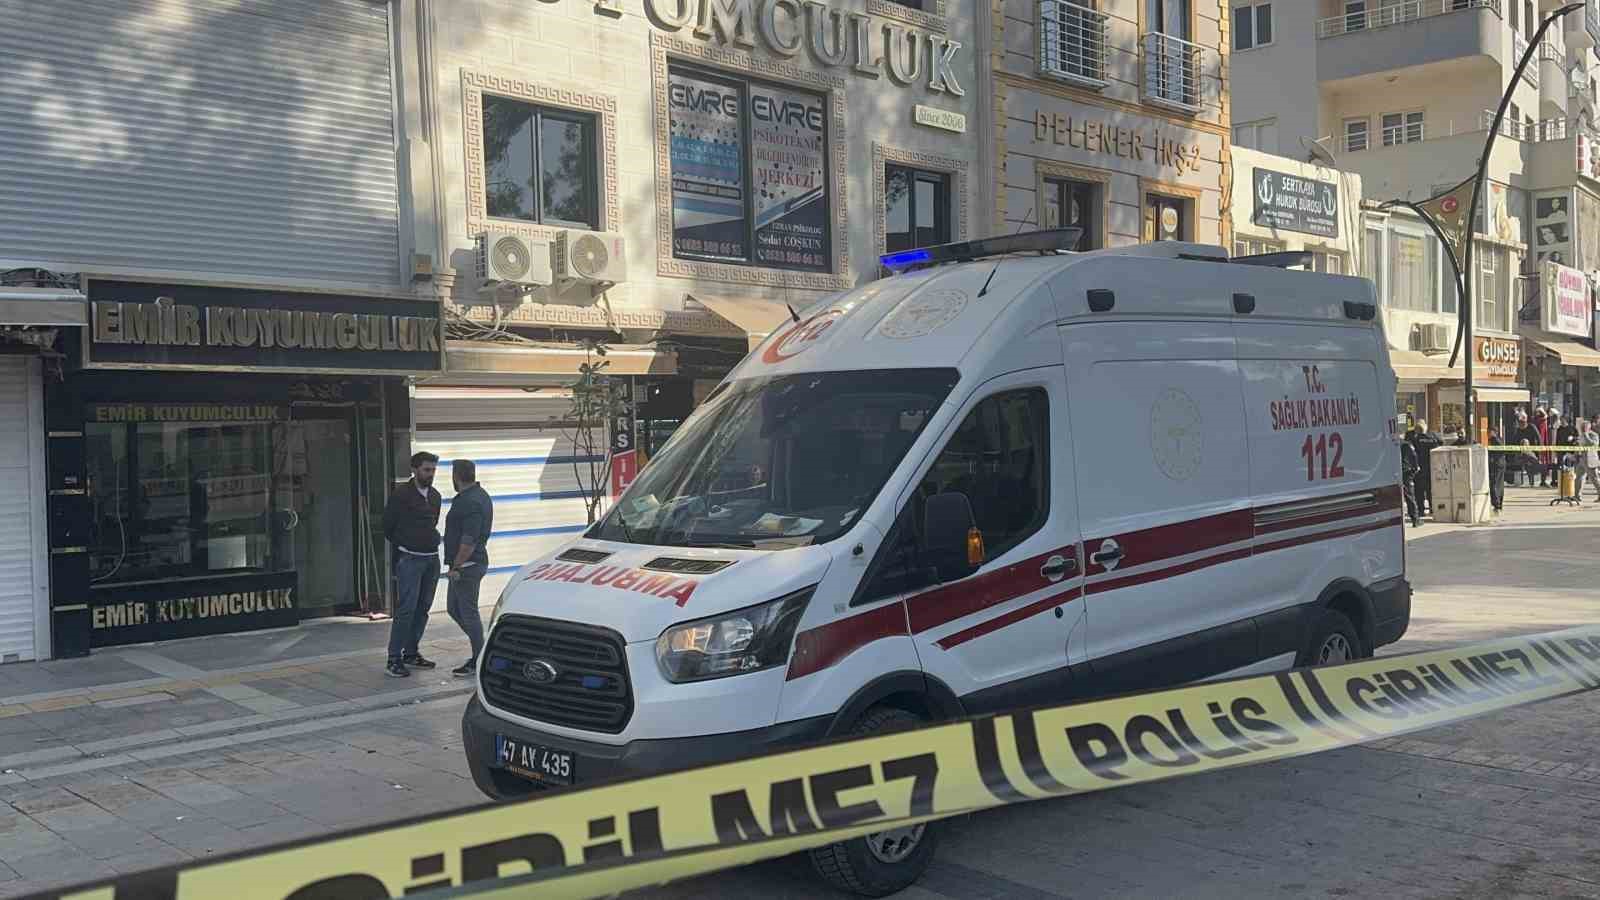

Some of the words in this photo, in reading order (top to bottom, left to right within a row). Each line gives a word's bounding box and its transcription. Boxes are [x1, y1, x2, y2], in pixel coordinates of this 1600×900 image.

[669, 83, 738, 119] EMRE
[752, 95, 822, 131] EMRE
[1033, 108, 1144, 162] DELENER
[91, 296, 201, 346] EMİR
[205, 305, 439, 352] KUYUMCULUK
[96, 400, 147, 422] EMİR
[153, 400, 280, 422] KUYUMCULUK
[1270, 394, 1309, 431] SAĞLIK
[1310, 391, 1361, 428] BAKANLIĞI
[1301, 432, 1345, 481] 112
[92, 600, 148, 629] EMİR
[157, 588, 294, 624] KUYUMCULUK
[1064, 697, 1299, 781] POLİS
[1345, 648, 1548, 719] GİRİLMEZ
[503, 739, 516, 762] 47
[541, 751, 571, 777] 435
